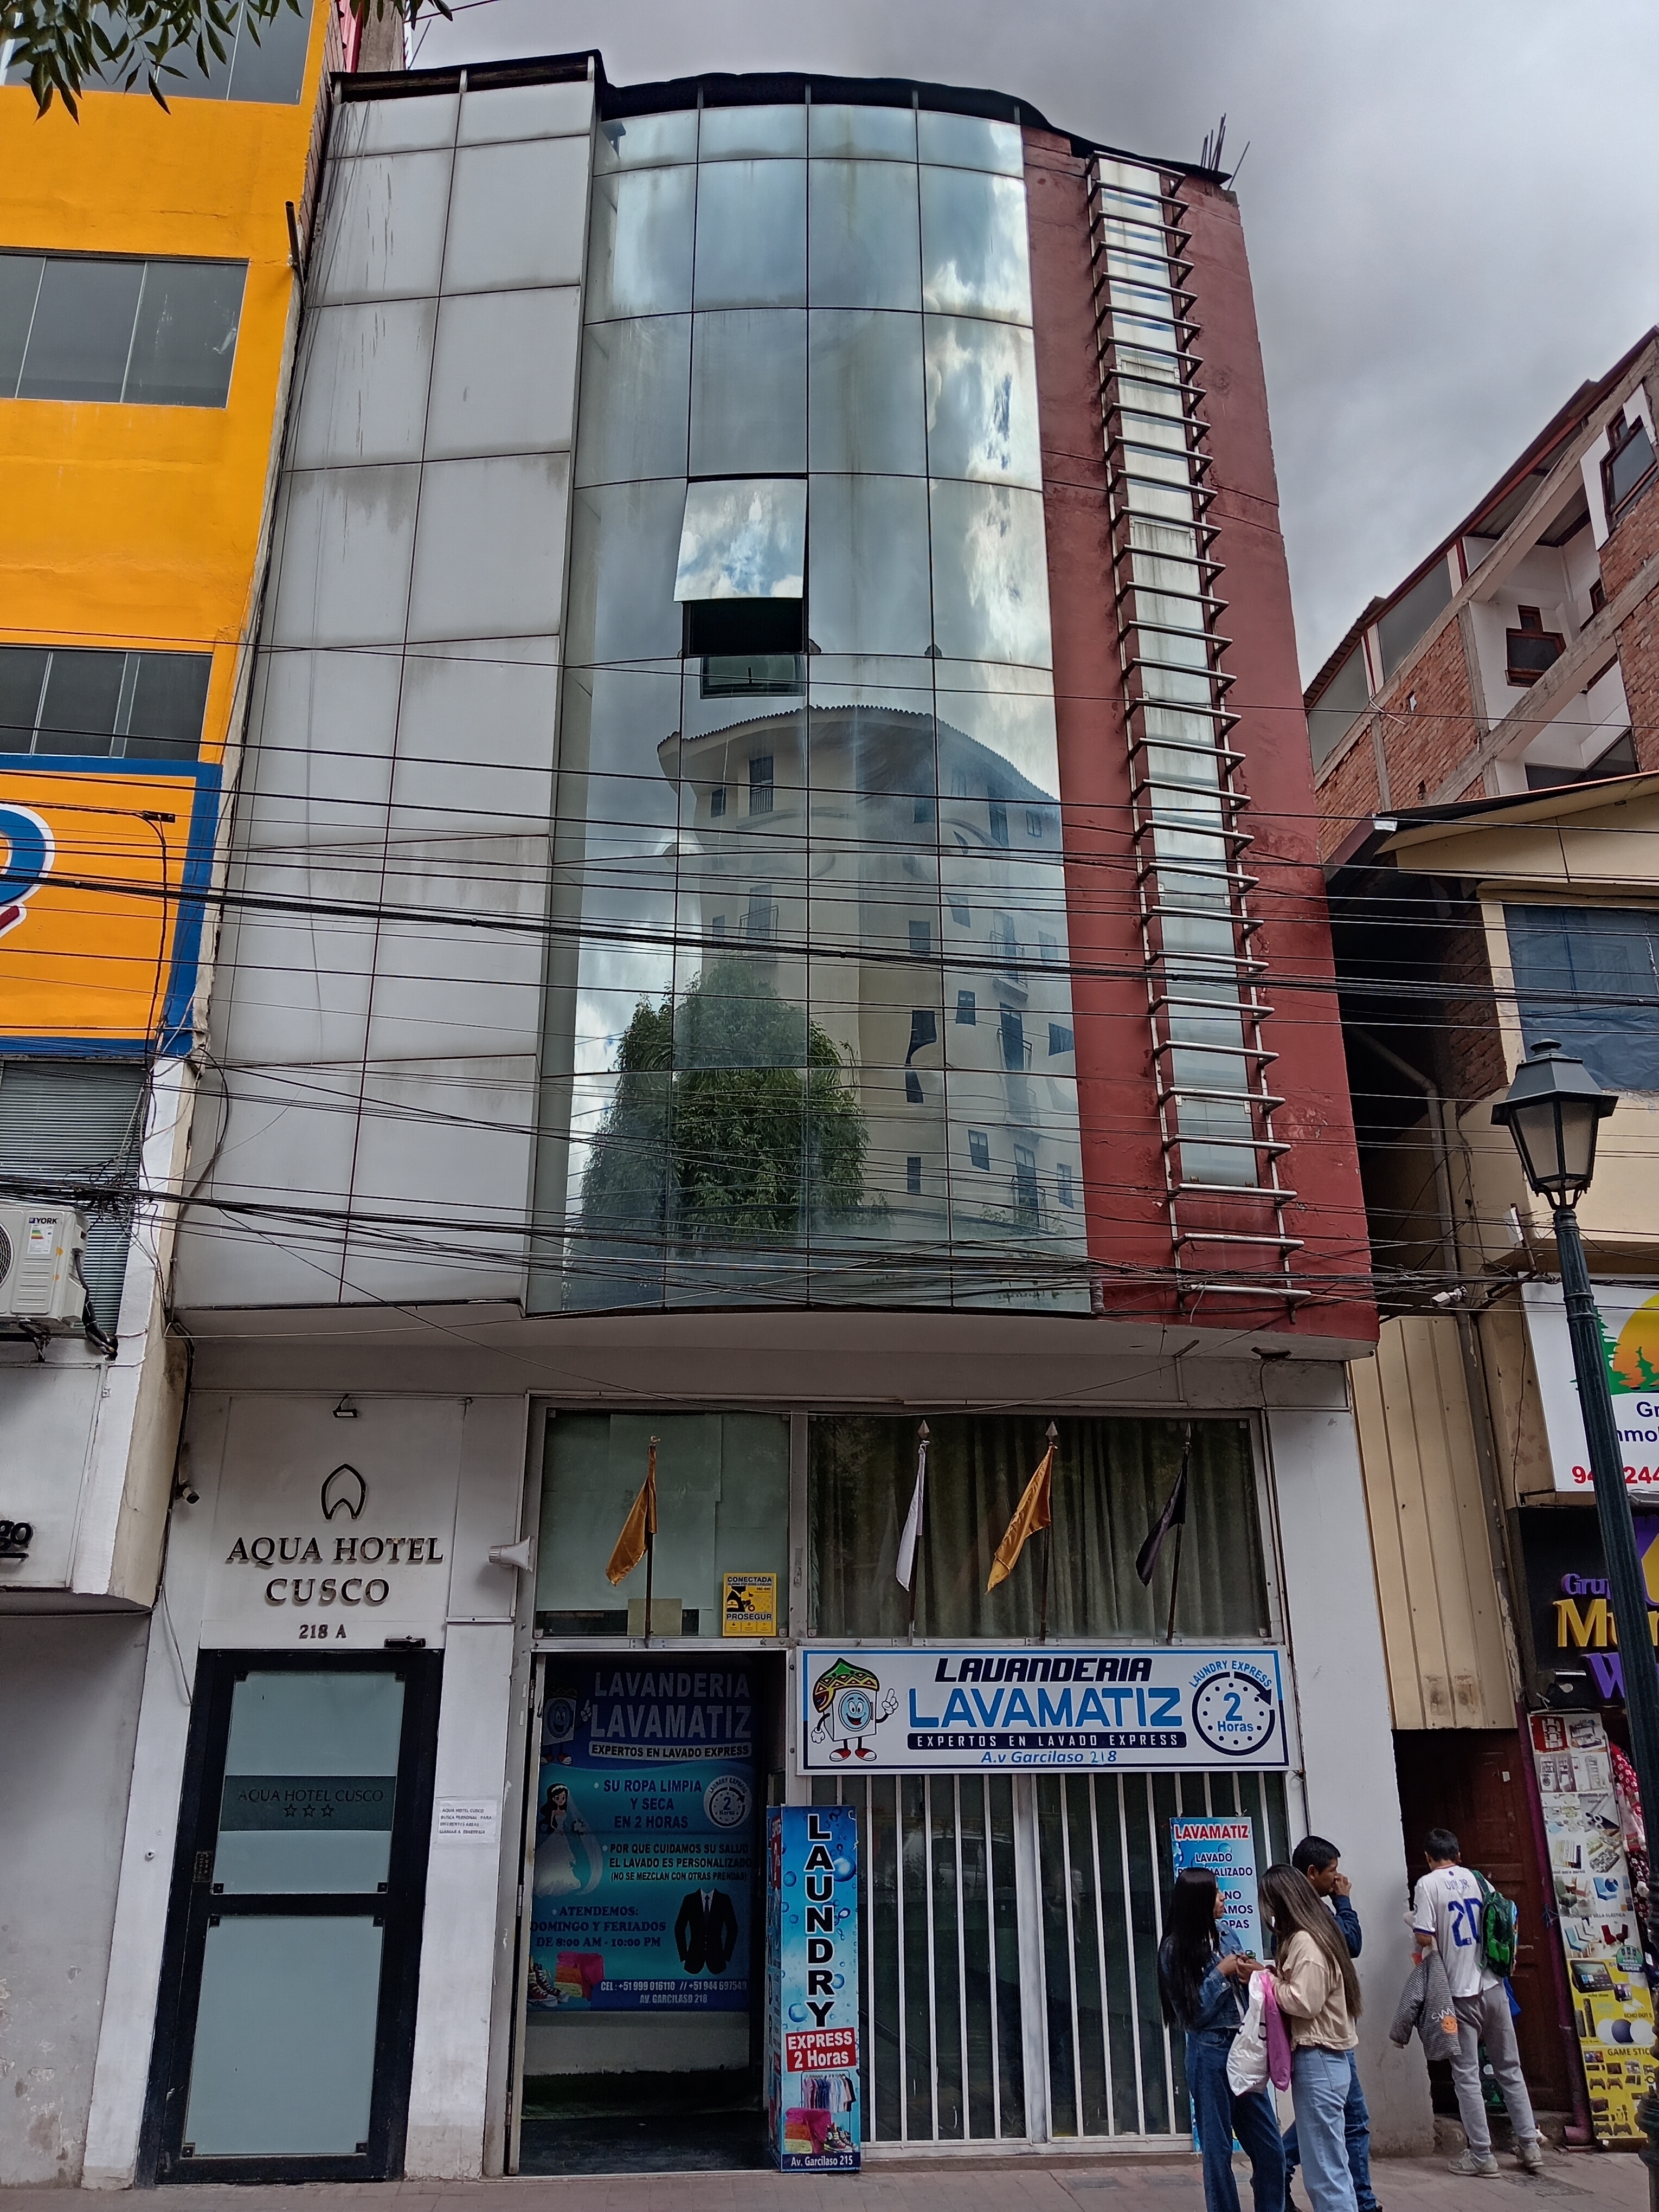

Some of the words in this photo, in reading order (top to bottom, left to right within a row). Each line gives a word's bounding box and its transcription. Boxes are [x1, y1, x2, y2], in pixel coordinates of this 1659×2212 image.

[226, 1536, 323, 1566] AQUA
[333, 1536, 443, 1561] HOTEL
[266, 1578, 390, 1603] CUSCO
[299, 1624, 329, 1639] 218
[335, 1624, 346, 1638] A
[934, 1657, 1153, 1682] LAVANDERIA
[1188, 1660, 1228, 1688] LAUNDRY
[1231, 1660, 1272, 1688] EXPRESS
[595, 1672, 750, 1698] LAVANDERIA
[909, 1687, 1182, 1728] LAVAMATIZ
[1223, 1692, 1243, 1721] 2
[590, 1704, 752, 1738] LAVAMATIZ
[1217, 1720, 1254, 1732] Horas
[917, 1735, 996, 1747] EXPERTOS
[1008, 1735, 1026, 1747] EN
[1038, 1734, 1097, 1747] LAVADO
[1109, 1734, 1178, 1746] EXPRESS
[591, 1744, 644, 1757] EXPERTOS
[646, 1747, 660, 1757] EN
[663, 1747, 702, 1758] LAVADO
[704, 1745, 749, 1757] EXPRESS
[981, 1751, 1006, 1763] A.v
[1011, 1750, 1084, 1763] Garcilaso
[1090, 1750, 1117, 1764] 218
[603, 1779, 620, 1792] SU
[624, 1780, 657, 1792] ROPA
[660, 1780, 702, 1792] LIMPIA
[239, 1789, 281, 1803] AQUA
[284, 1789, 331, 1802] HOTEL
[335, 1789, 384, 1802] CUSCO
[723, 1796, 731, 1810] 2
[630, 1798, 639, 1810] Y
[641, 1798, 674, 1810] SECA
[614, 1816, 631, 1828] EN
[634, 1816, 642, 1828] 2
[646, 1816, 689, 1828] HORAS
[1175, 1825, 1249, 1839] LAVAMATIZ
[610, 1843, 629, 1853] POR
[653, 1843, 702, 1854] CUIDAMOS
[704, 1843, 716, 1854] SU
[718, 1843, 749, 1854] SALUD
[609, 1857, 621, 1868] EL
[623, 1857, 660, 1868] LAVADO
[662, 1857, 674, 1868] ES
[676, 1857, 753, 1868] PERSONALIZADO
[1195, 1853, 1233, 1862] LAVADO
[611, 1872, 624, 1882] (NO
[626, 1872, 634, 1880] SE
[636, 1872, 670, 1881] MEZCLAN
[671, 1872, 686, 1881] CON
[688, 1872, 711, 1880] OTRAS
[713, 1872, 747, 1881] PRENDAS)
[1224, 1890, 1242, 1900] NO
[559, 1906, 639, 1916] ATENDEMOS:
[531, 1921, 589, 1932] DOMINGO
[592, 1921, 601, 1931] Y
[603, 1921, 666, 1932] FERIADOS
[804, 1815, 836, 2028] LAUNDRY
[1448, 1897, 1483, 1947] 20
[536, 1937, 553, 1947] DE
[556, 1938, 580, 1947] 8:00
[582, 1937, 602, 1947] AM
[611, 1938, 641, 1947] 10:00
[644, 1937, 661, 1947] PM
[633, 1981, 648, 1991] 999
[639, 1994, 651, 2004] AV.
[652, 1994, 693, 2004] GARCILASO
[788, 2031, 853, 2050] EXPRESS
[794, 2050, 803, 2069] 2
[807, 2049, 850, 2067] Horas
[1607, 2048, 1631, 2056] GAME
[790, 2157, 803, 2166] Av.
[805, 2155, 838, 2166] Garcilaso
